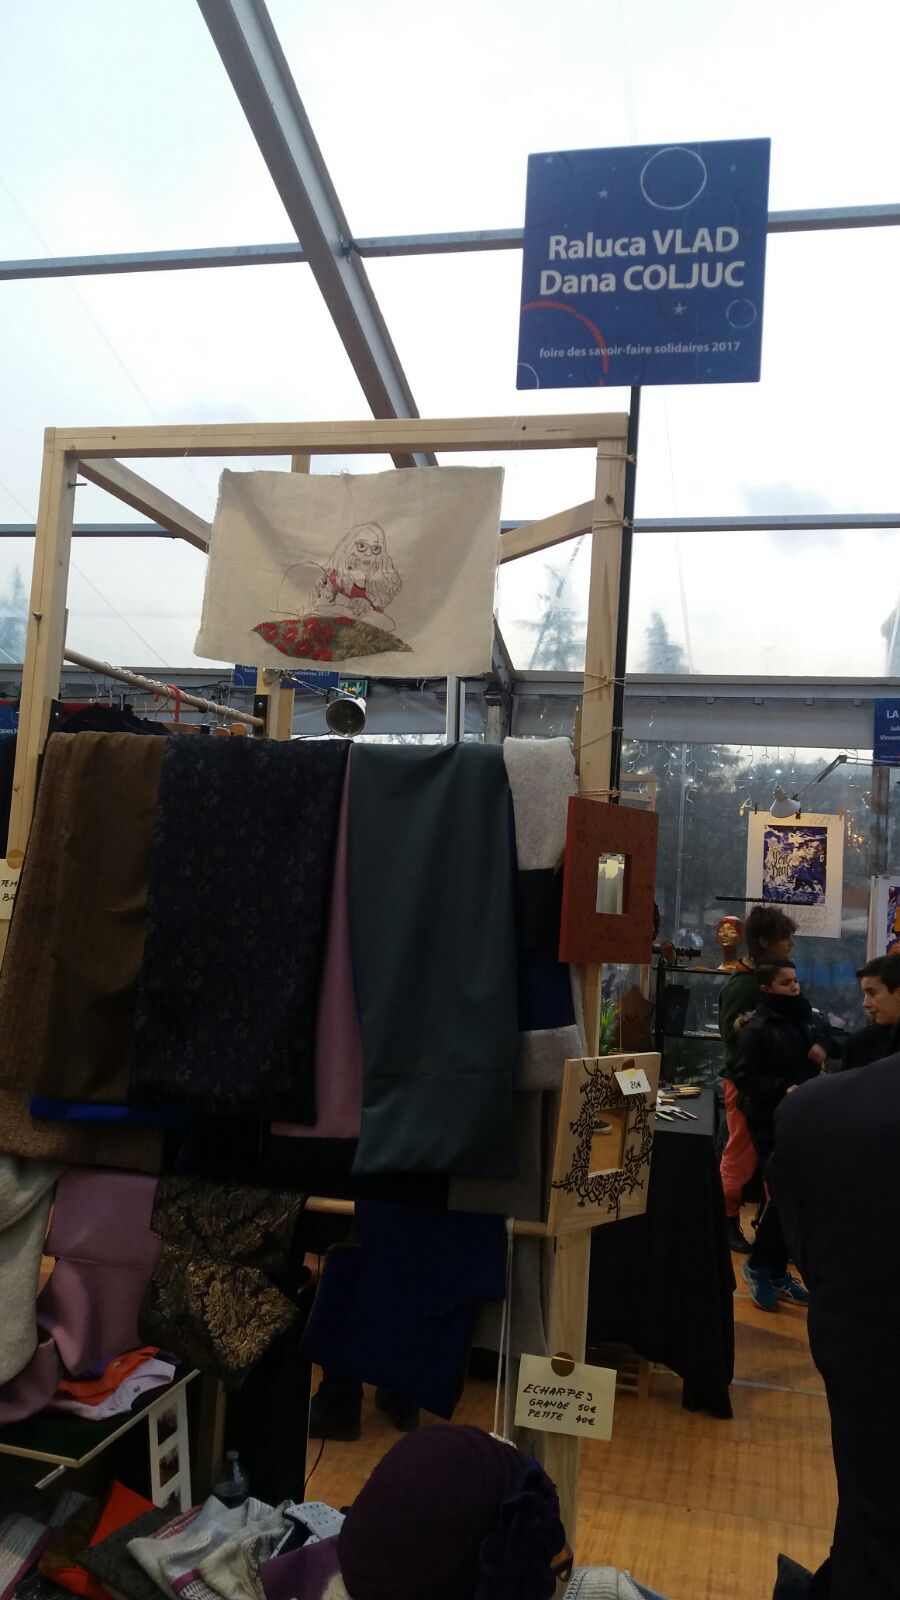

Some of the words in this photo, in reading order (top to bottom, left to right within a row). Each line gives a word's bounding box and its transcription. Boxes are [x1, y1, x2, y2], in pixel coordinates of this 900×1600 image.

[548, 231, 646, 260] Raluca
[652, 226, 740, 254] VLAD
[539, 269, 616, 295] Dana
[623, 260, 745, 290] COLJUC
[539, 347, 566, 358] foire
[567, 346, 586, 357] des
[588, 343, 652, 356] savoir-faire
[654, 341, 709, 354] solidaires
[712, 341, 740, 352] 2017
[886, 710, 900, 719] LA
[523, 1383, 593, 1402] ECHARPES
[529, 1398, 570, 1410] GRANDE
[577, 1403, 597, 1414] 50€
[527, 1408, 565, 1421] PETITE
[575, 1414, 597, 1426] 40€
